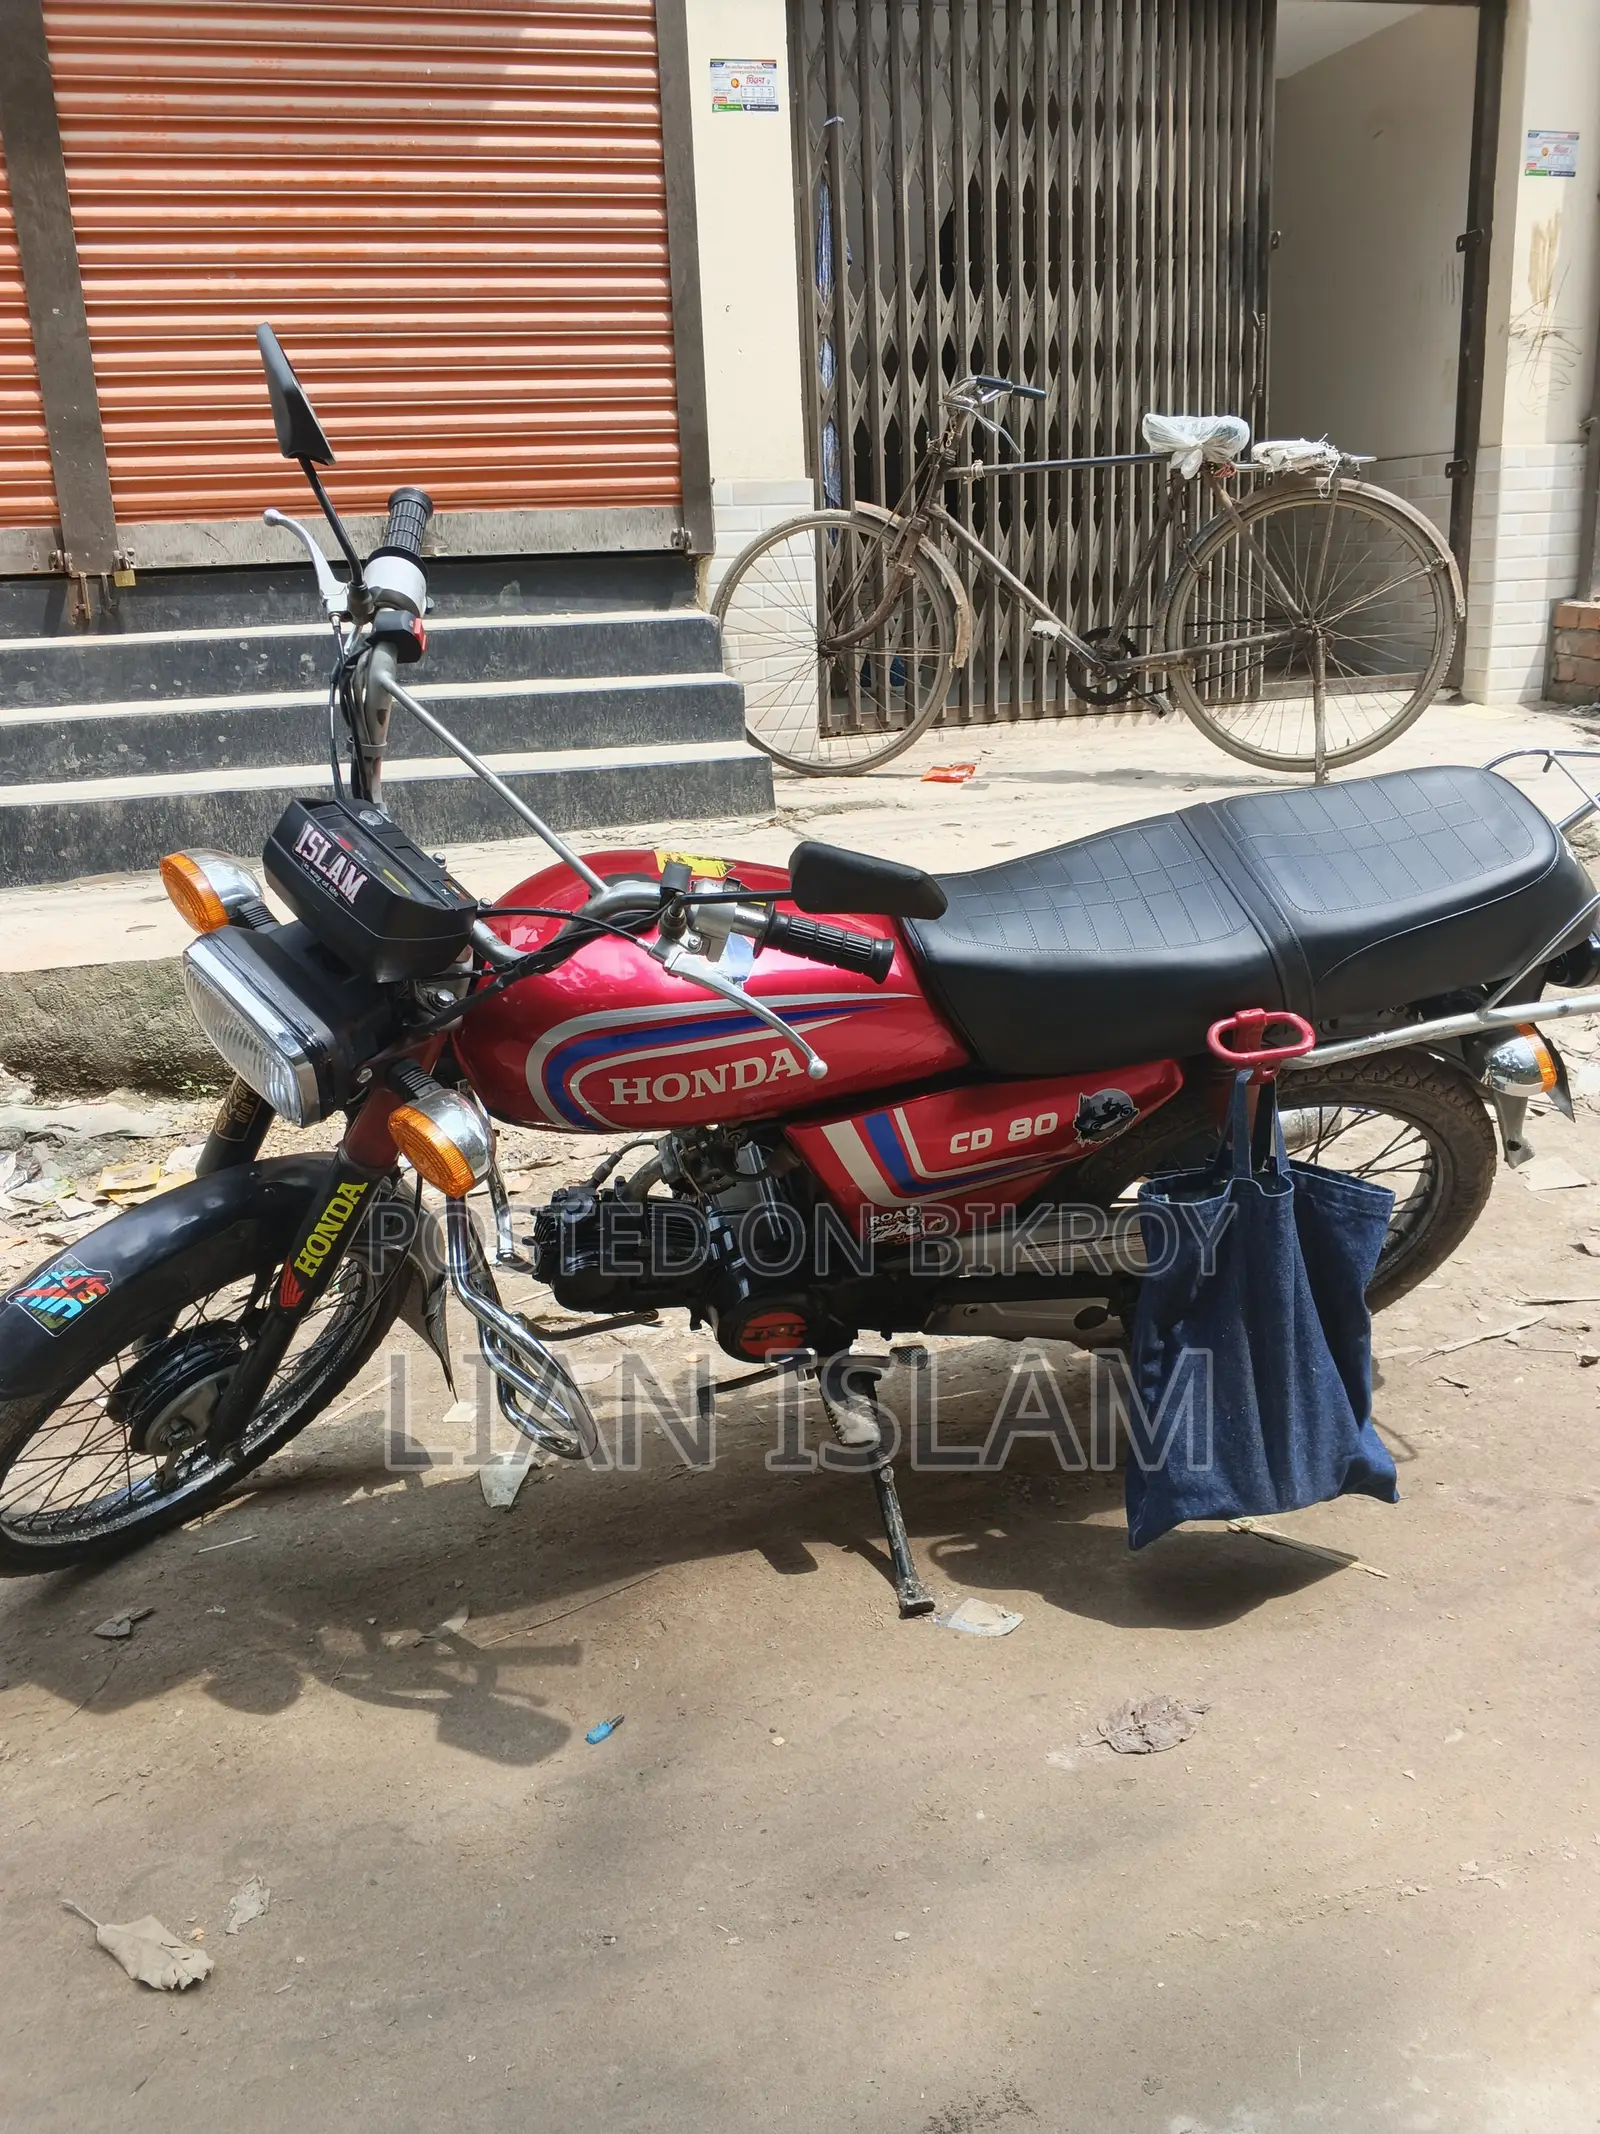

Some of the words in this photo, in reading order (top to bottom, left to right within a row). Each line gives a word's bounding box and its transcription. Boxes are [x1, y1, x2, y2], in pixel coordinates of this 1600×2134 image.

[294, 822, 369, 904] ISLAM
[310, 869, 322, 882] way
[328, 885, 339, 898] life
[608, 1047, 804, 1105] HONDA
[950, 1128, 993, 1154] CD
[1007, 1112, 1058, 1142] 80
[294, 1181, 368, 1278] HONDA
[870, 1207, 918, 1227] ROAD
